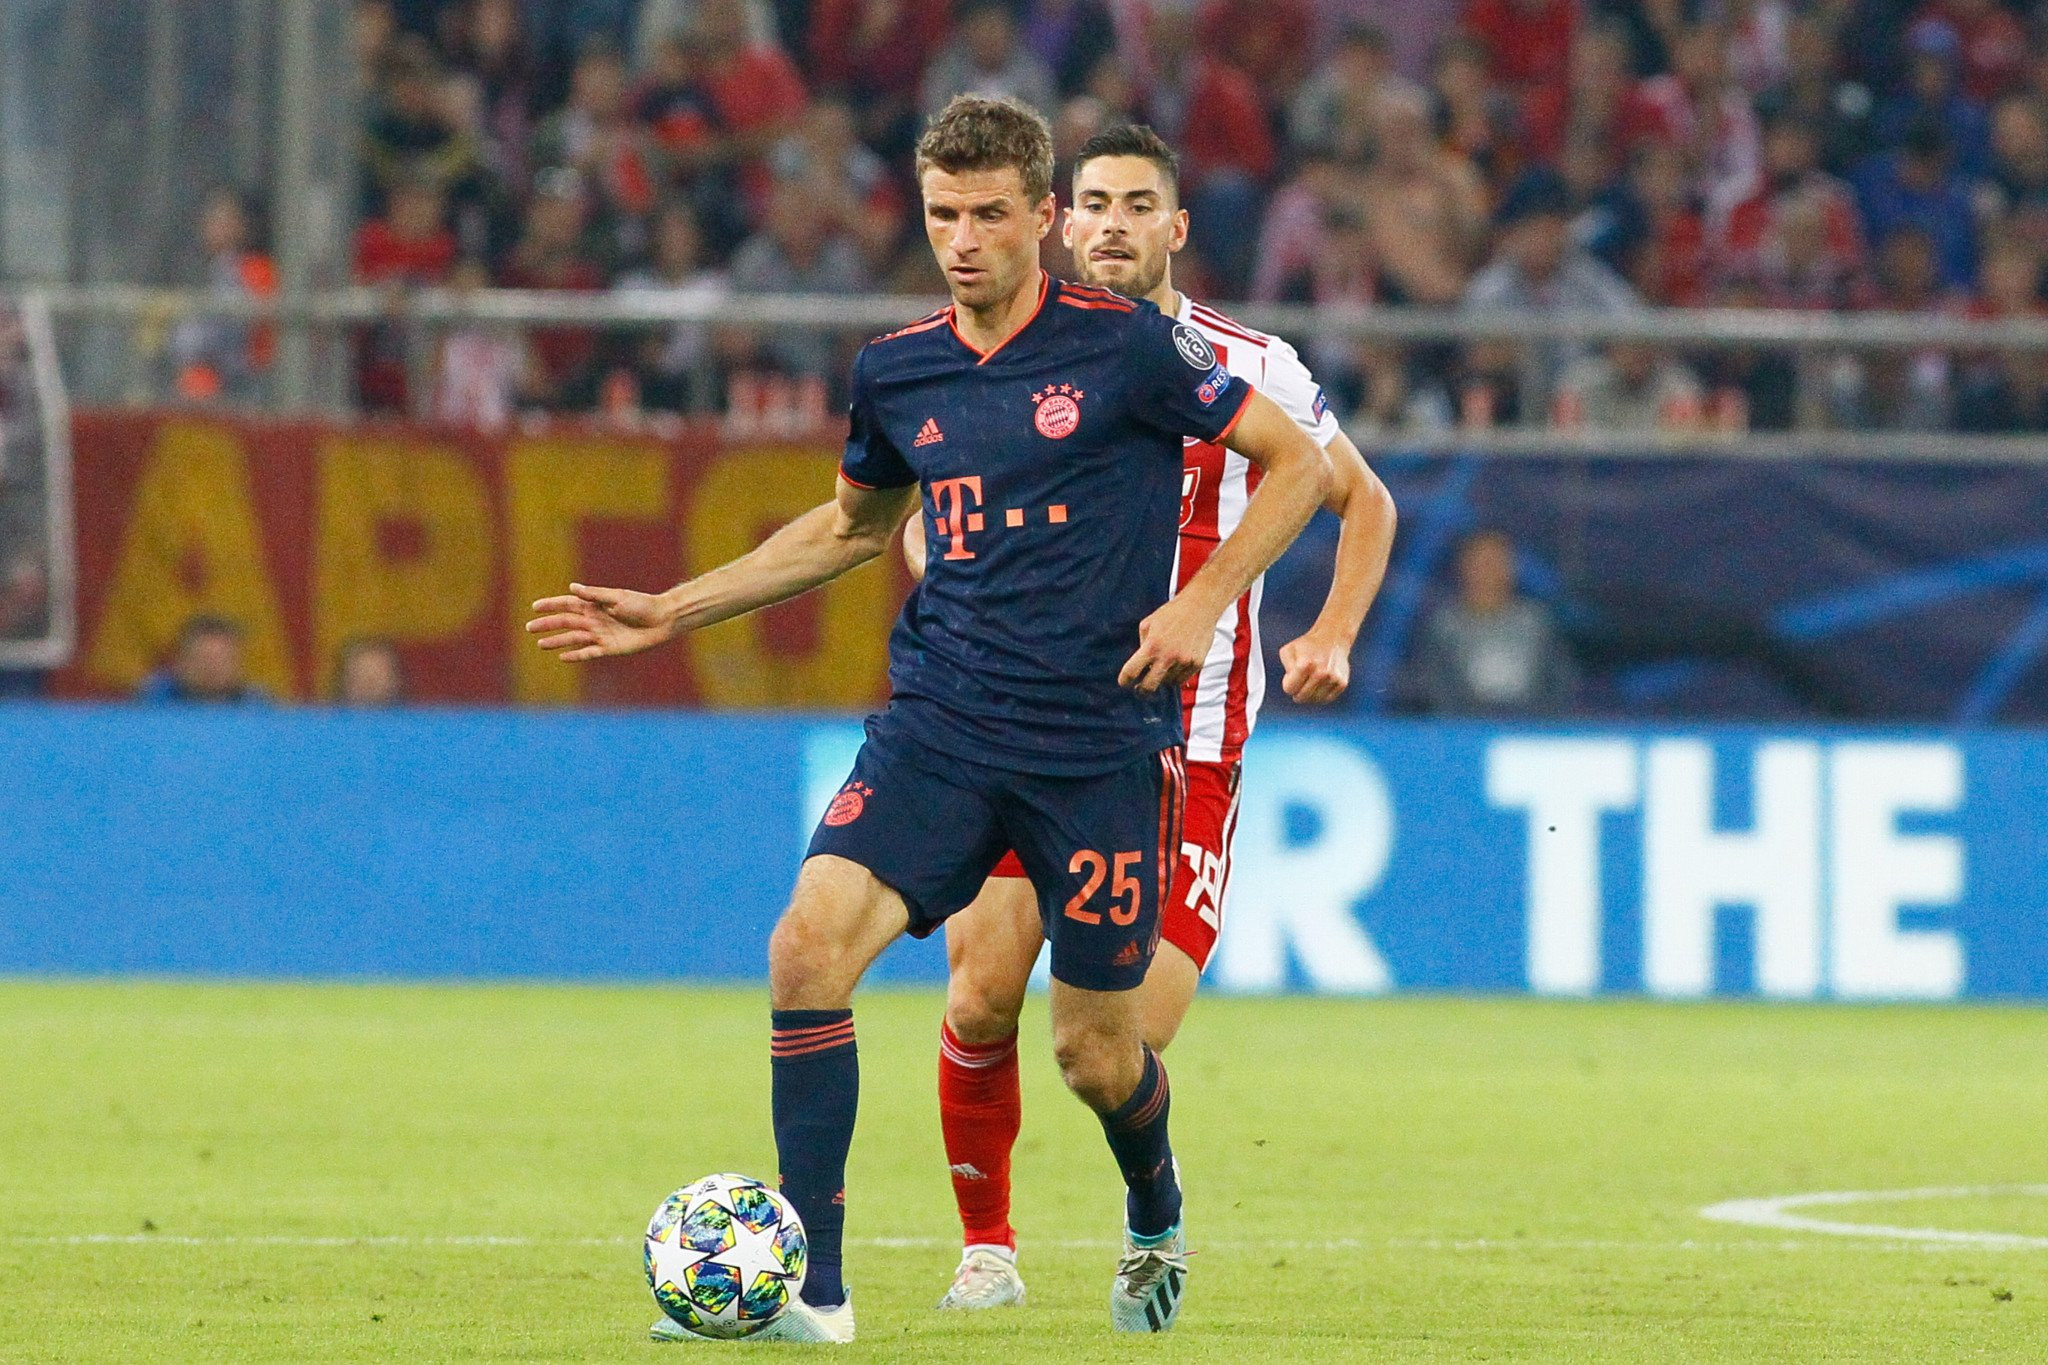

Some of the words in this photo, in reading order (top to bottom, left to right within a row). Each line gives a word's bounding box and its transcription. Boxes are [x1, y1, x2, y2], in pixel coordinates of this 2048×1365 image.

[913, 432, 944, 448] adidas
[1064, 849, 1142, 926] 25
[1486, 738, 1965, 998] THE
